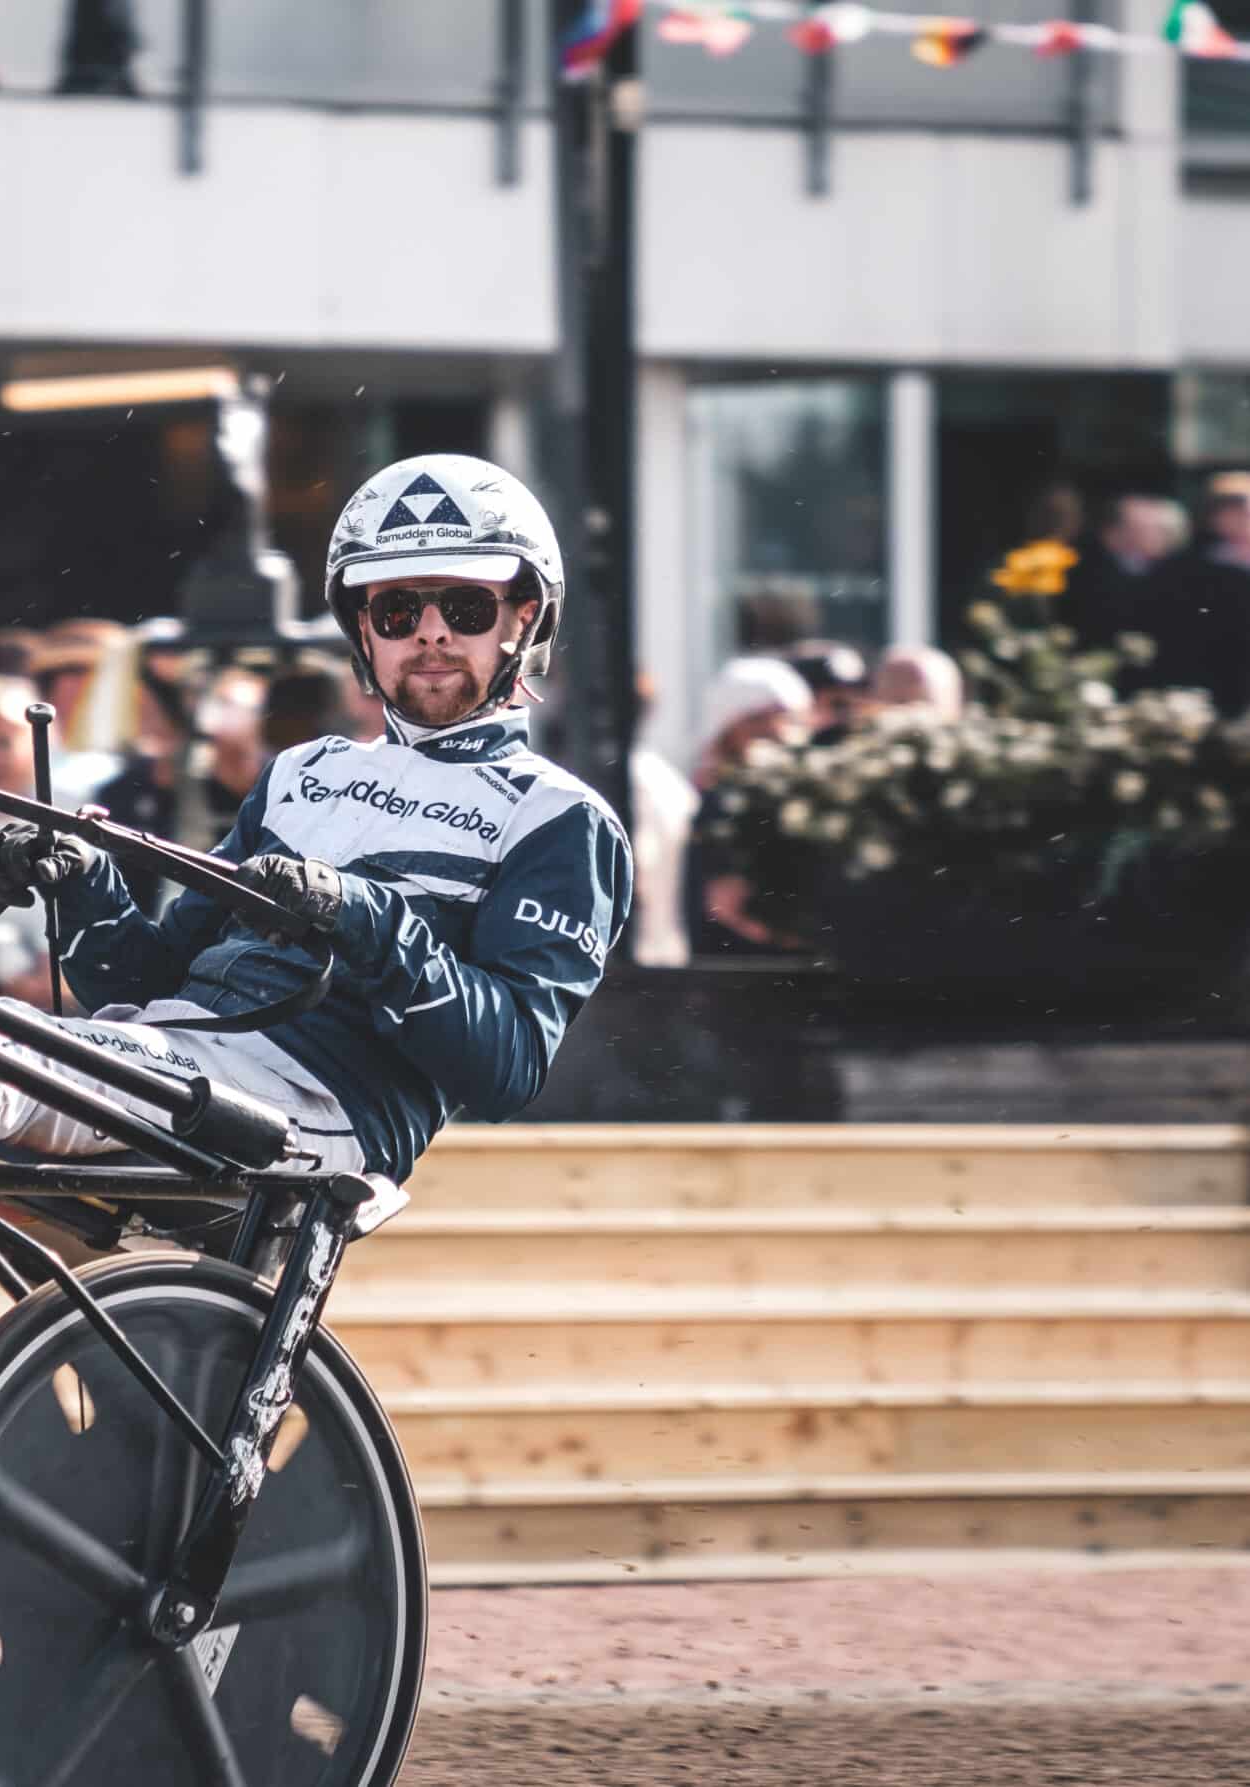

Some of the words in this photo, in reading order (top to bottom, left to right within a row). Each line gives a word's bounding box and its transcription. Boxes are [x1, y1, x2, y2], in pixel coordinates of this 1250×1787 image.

[376, 528, 433, 545] Ramudden
[436, 527, 472, 539] Global
[300, 775, 419, 818] Radden
[145, 1043, 201, 1073] Gobal
